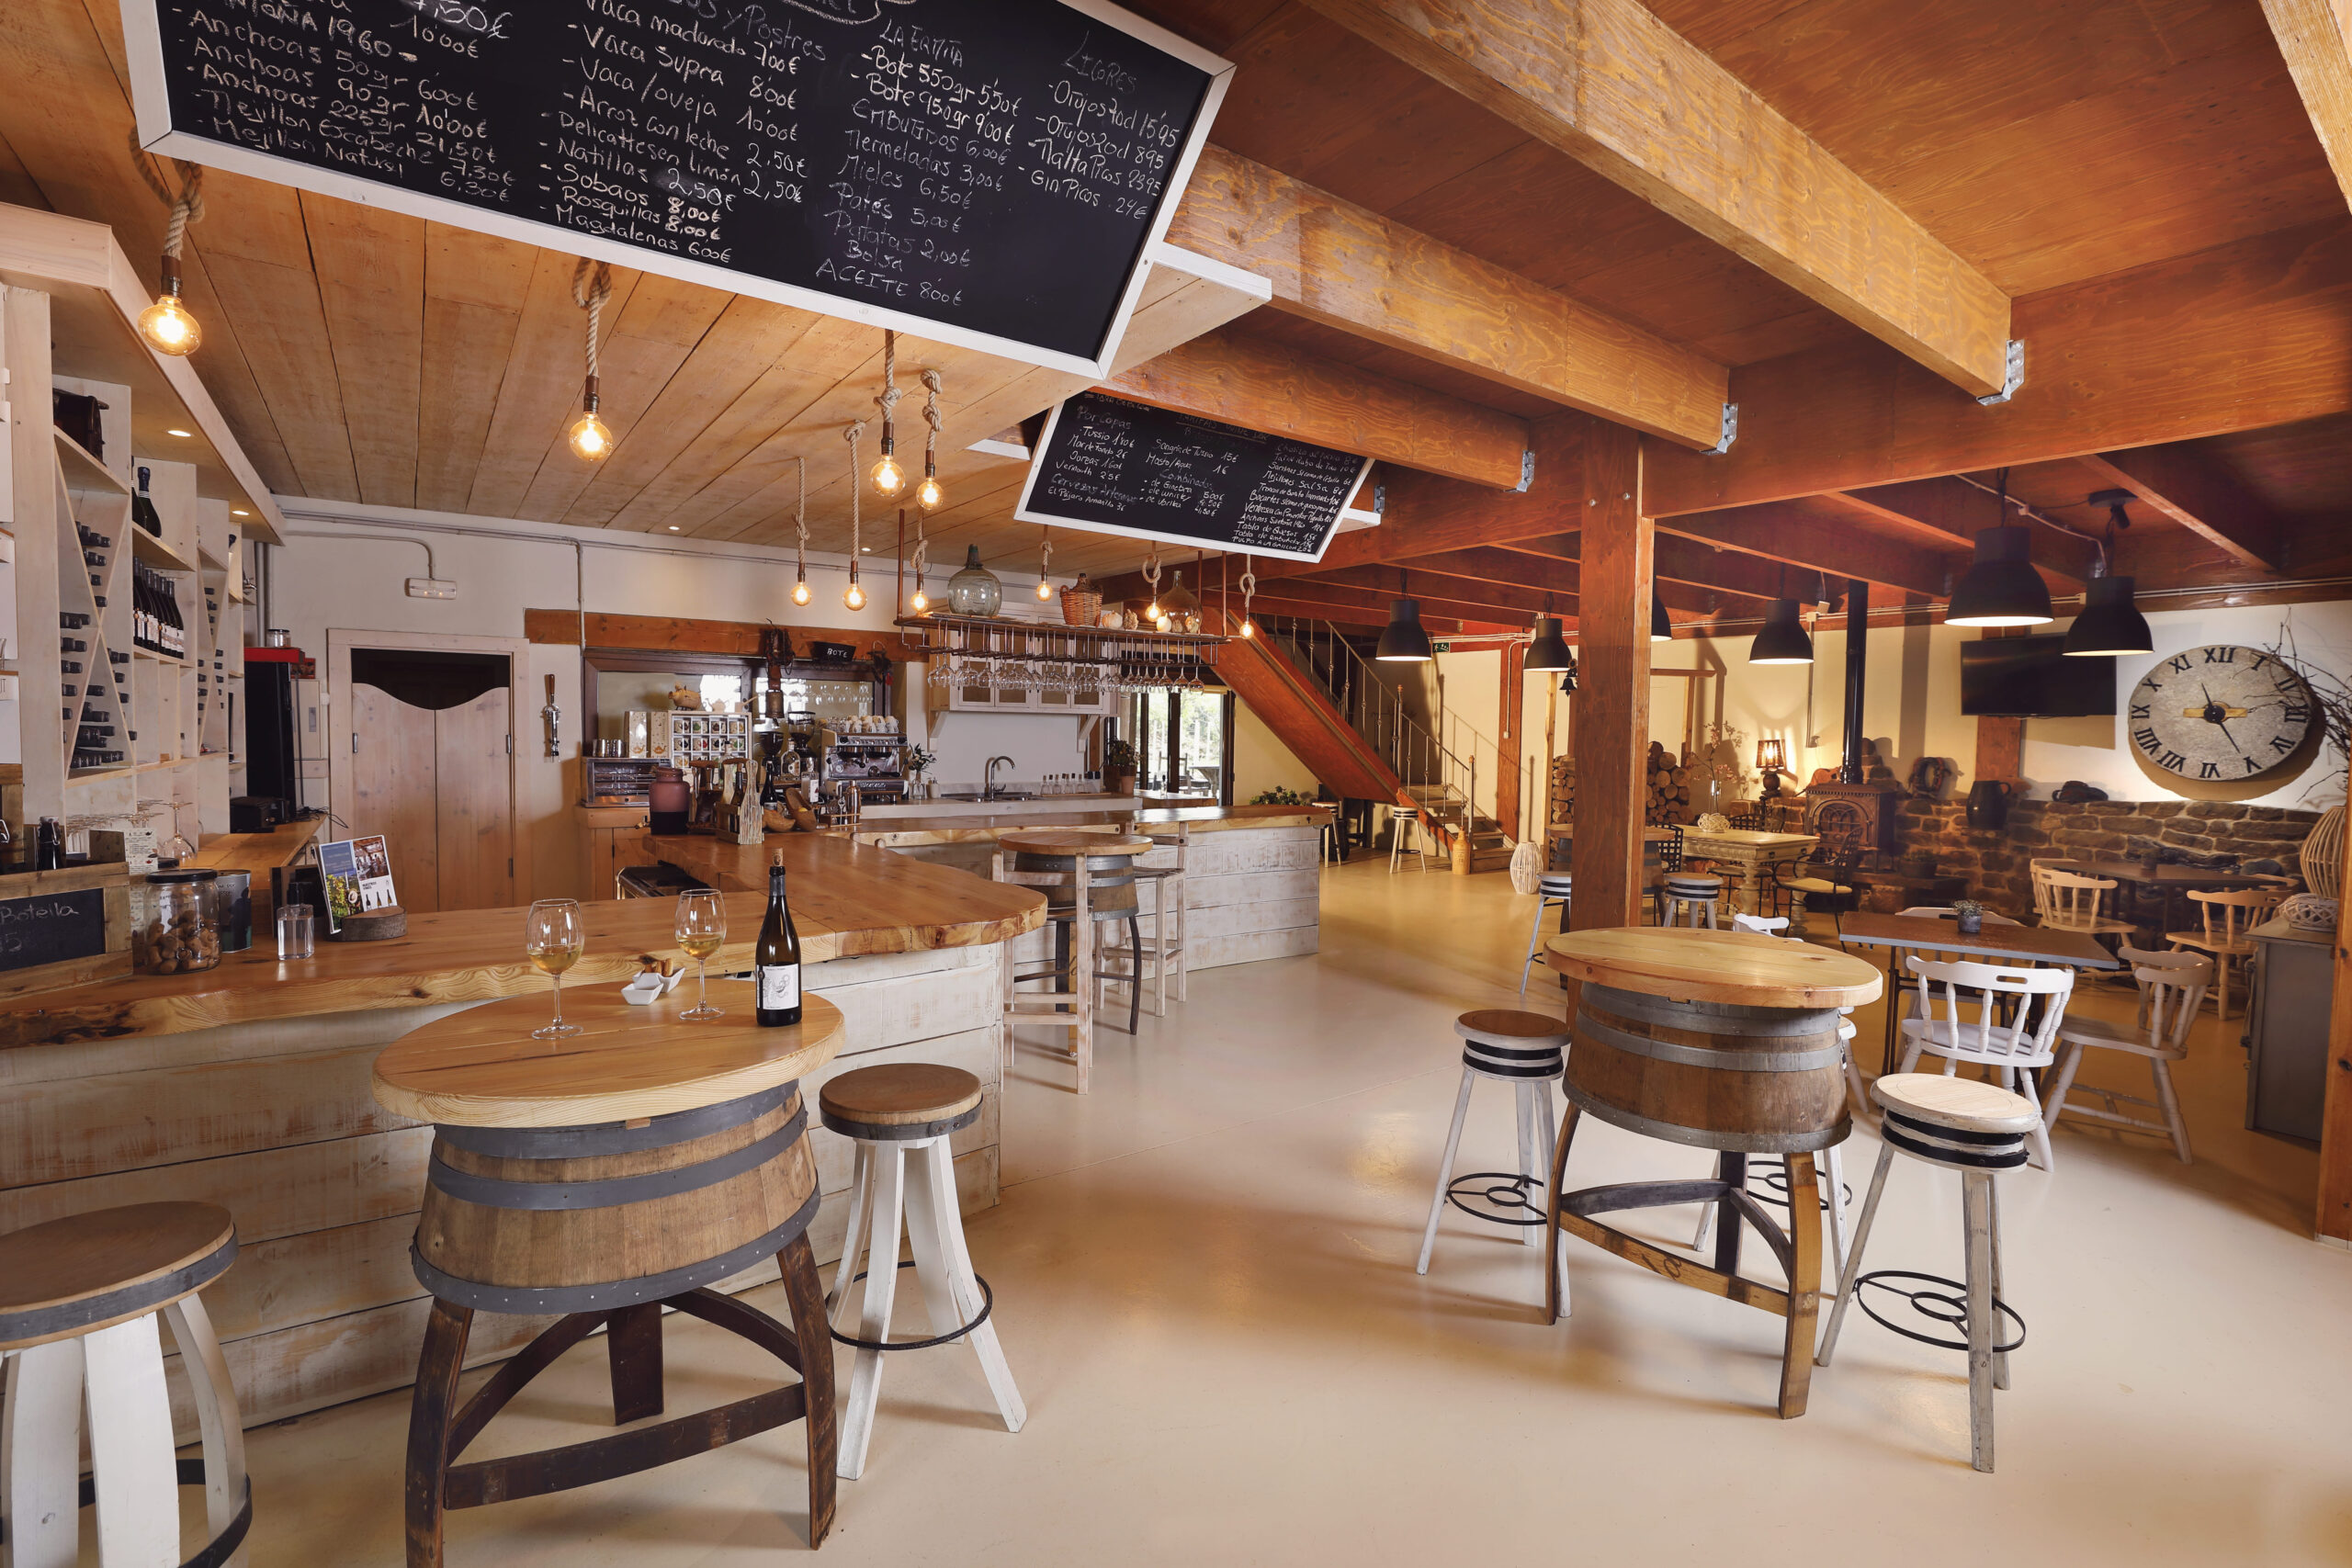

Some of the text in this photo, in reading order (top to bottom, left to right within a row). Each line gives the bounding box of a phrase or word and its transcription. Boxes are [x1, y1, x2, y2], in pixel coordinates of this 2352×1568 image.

[189, 10, 322, 63] Anchoas
[582, 23, 645, 62] Vaca
[879, 18, 904, 47] LA
[195, 37, 314, 86] Anchoas
[871, 45, 913, 78] Bote
[203, 63, 320, 108] Anchoas
[865, 73, 915, 107] Bote
[685, 122, 729, 160] leche
[558, 137, 649, 184] Natillas
[837, 154, 903, 188] Mieles
[557, 163, 649, 207] Sobaos
[561, 186, 661, 223] Rosquillas
[555, 204, 679, 251] Magdalenas
[815, 257, 909, 297] ACEITE
[827, 648, 848, 659] BOTE
[2168, 654, 2193, 674] XI
[2204, 648, 2236, 663] XII
[2143, 678, 2163, 692] X
[2132, 704, 2151, 719] IX
[2243, 756, 2262, 773] V
